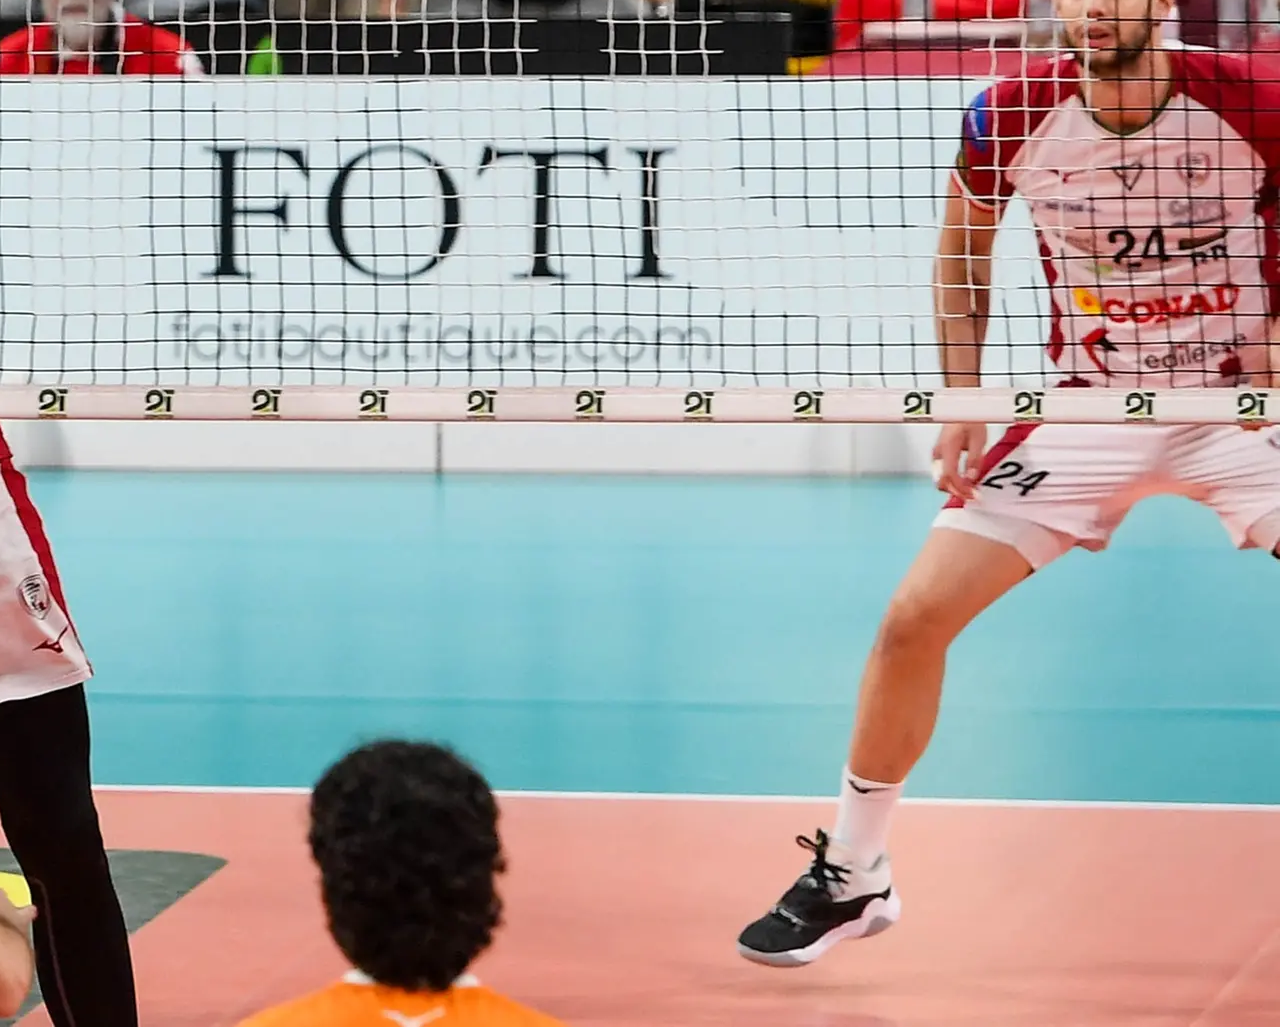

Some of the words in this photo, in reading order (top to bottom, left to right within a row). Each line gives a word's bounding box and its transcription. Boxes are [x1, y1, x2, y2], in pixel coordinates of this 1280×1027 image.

[200, 144, 677, 280] FOTI
[1108, 229, 1171, 267] 24
[1104, 284, 1240, 324] CONAD
[172, 312, 713, 368] fotiboutique.com
[982, 461, 1050, 496] 24
